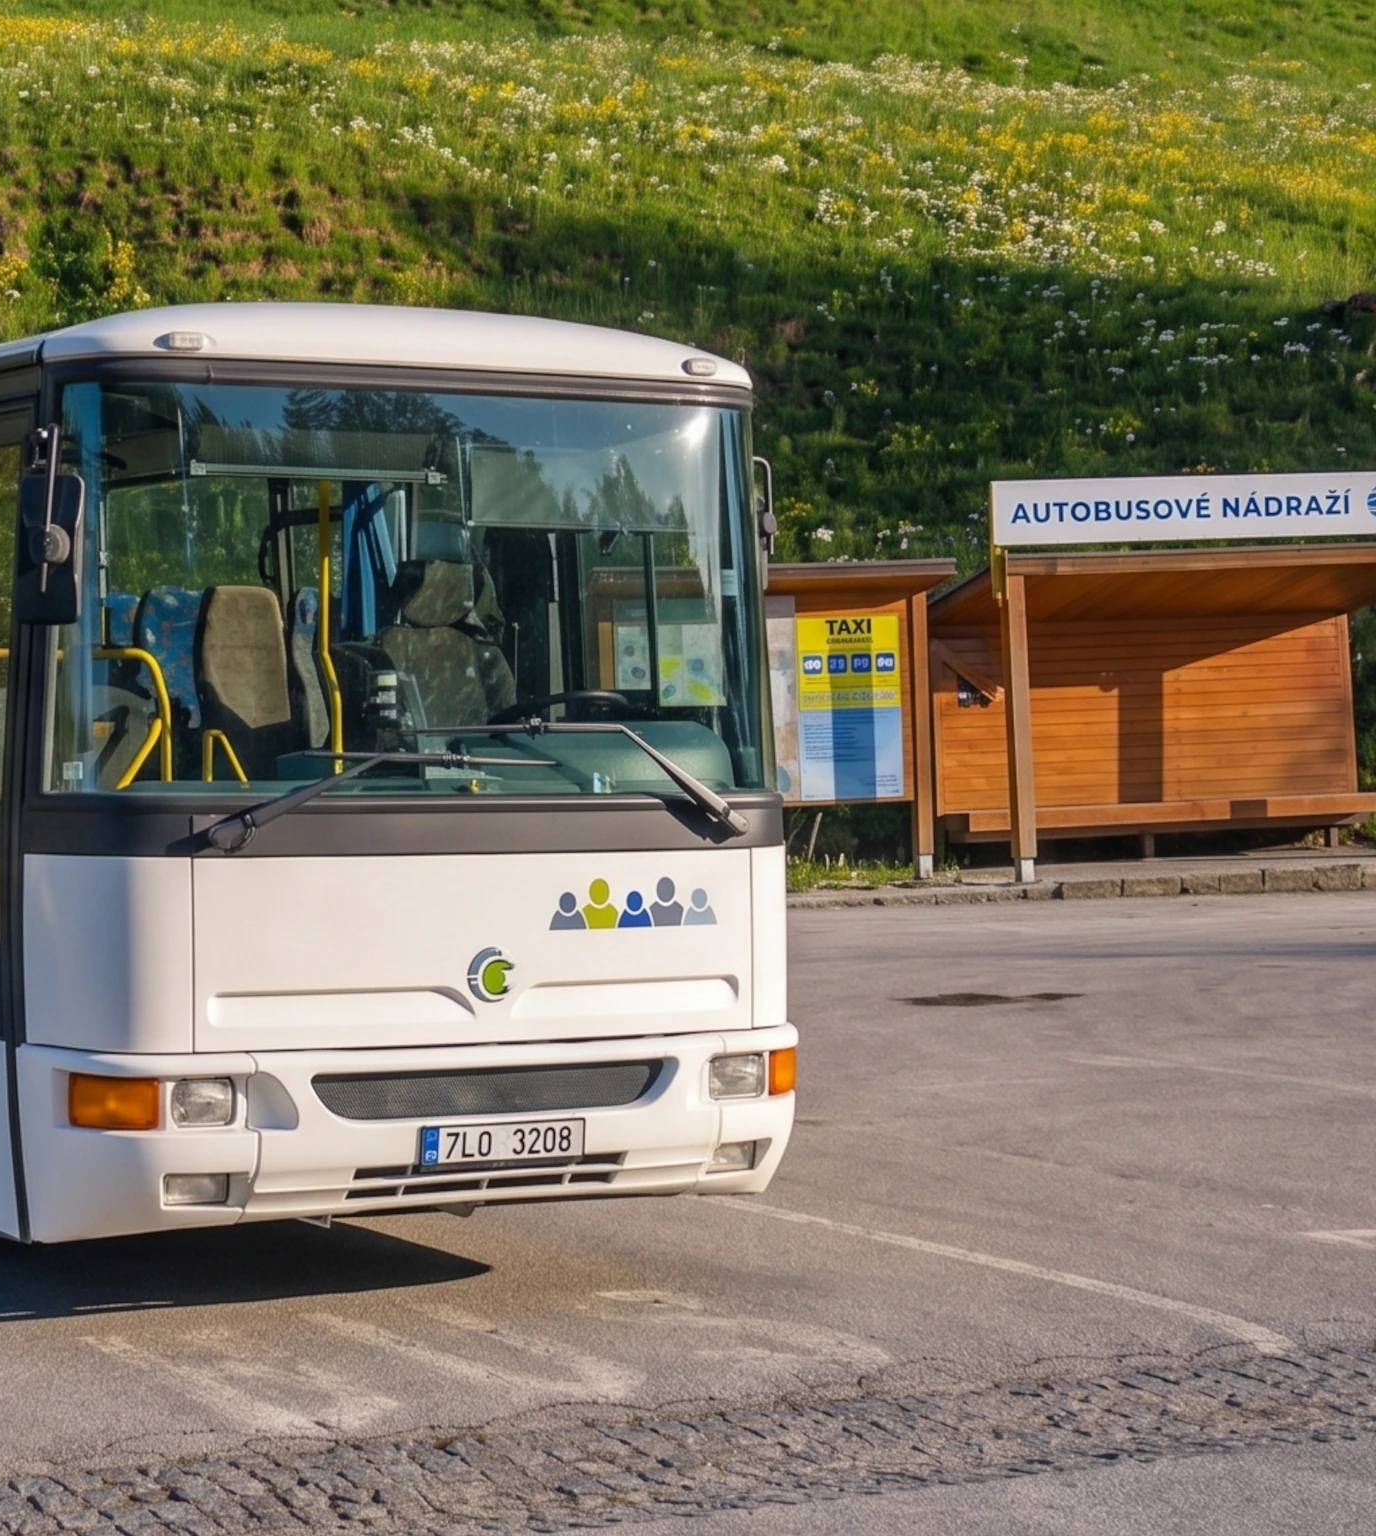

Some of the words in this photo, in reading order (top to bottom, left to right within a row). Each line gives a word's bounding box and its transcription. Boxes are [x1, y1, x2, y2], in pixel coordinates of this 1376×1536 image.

[1011, 492, 1211, 524] AUTOBUSOVÉ
[1222, 488, 1351, 518] NÁDRAŽÍ
[825, 618, 872, 636] TAXI
[512, 1125, 572, 1156] 3208
